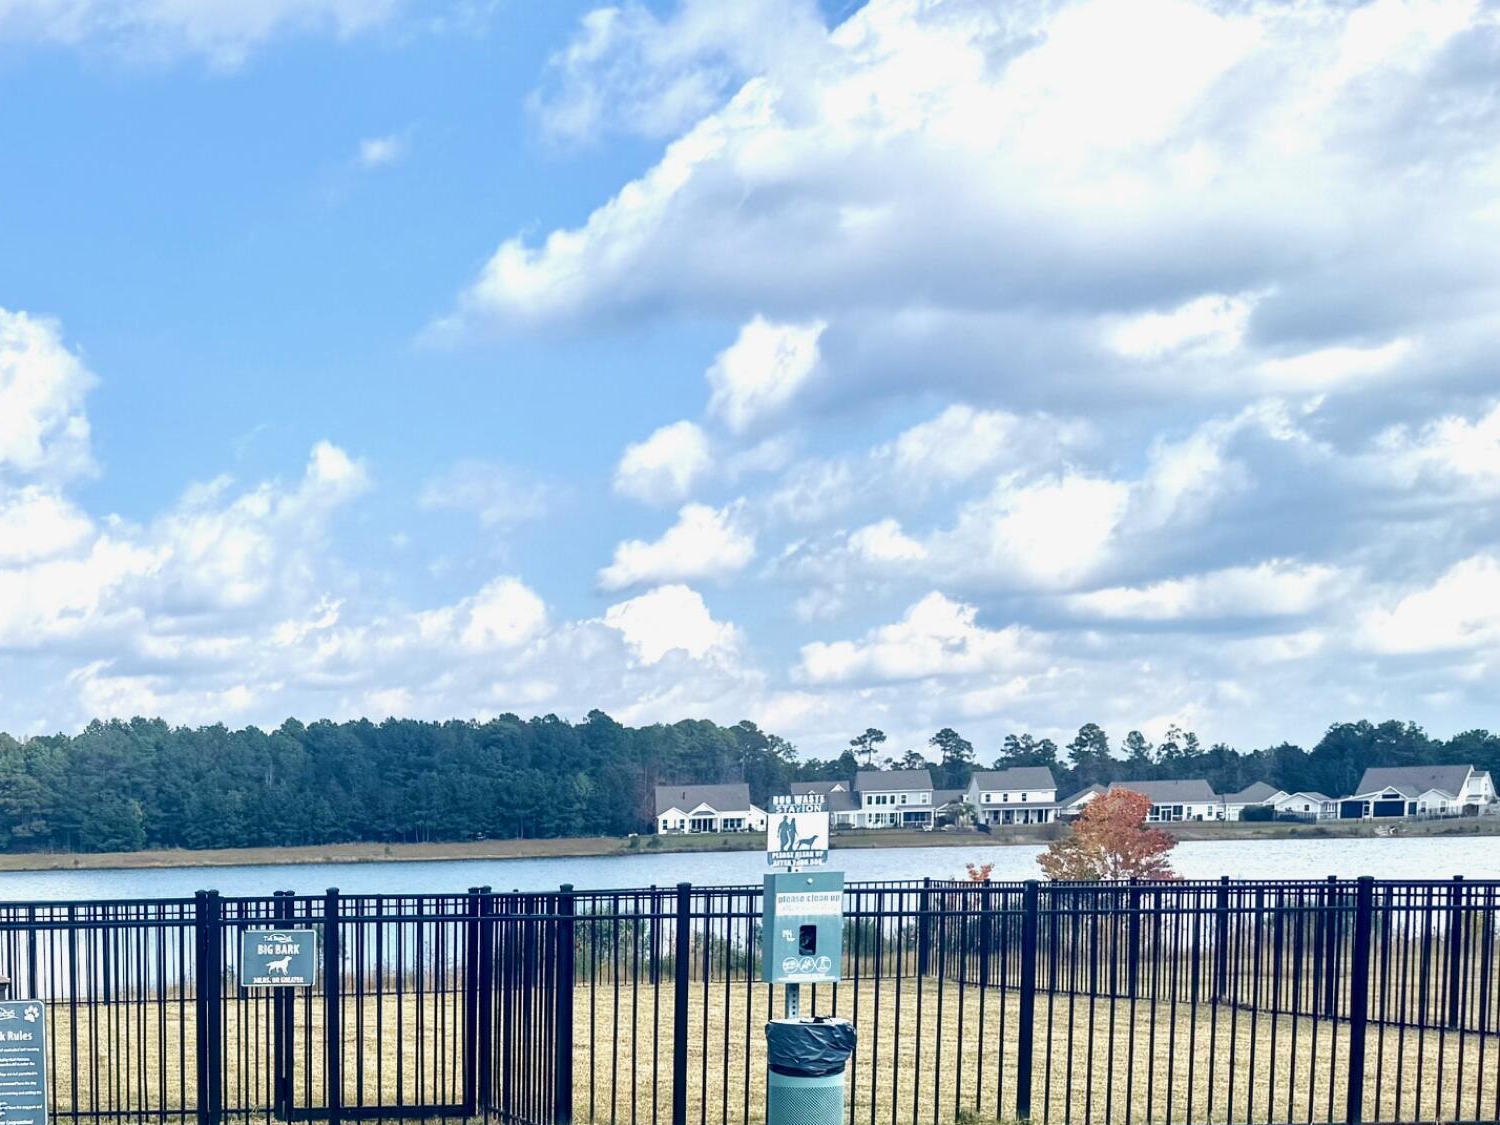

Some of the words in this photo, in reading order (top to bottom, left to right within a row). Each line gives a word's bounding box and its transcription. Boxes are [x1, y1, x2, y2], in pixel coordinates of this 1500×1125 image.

[794, 794, 825, 804] WASTE
[775, 804, 822, 813] STATION
[778, 895, 805, 903] please
[807, 894, 829, 902] clean
[830, 894, 841, 902] up
[257, 944, 274, 955] BIG
[275, 944, 300, 955] BARK
[7, 1030, 33, 1041] Rules
